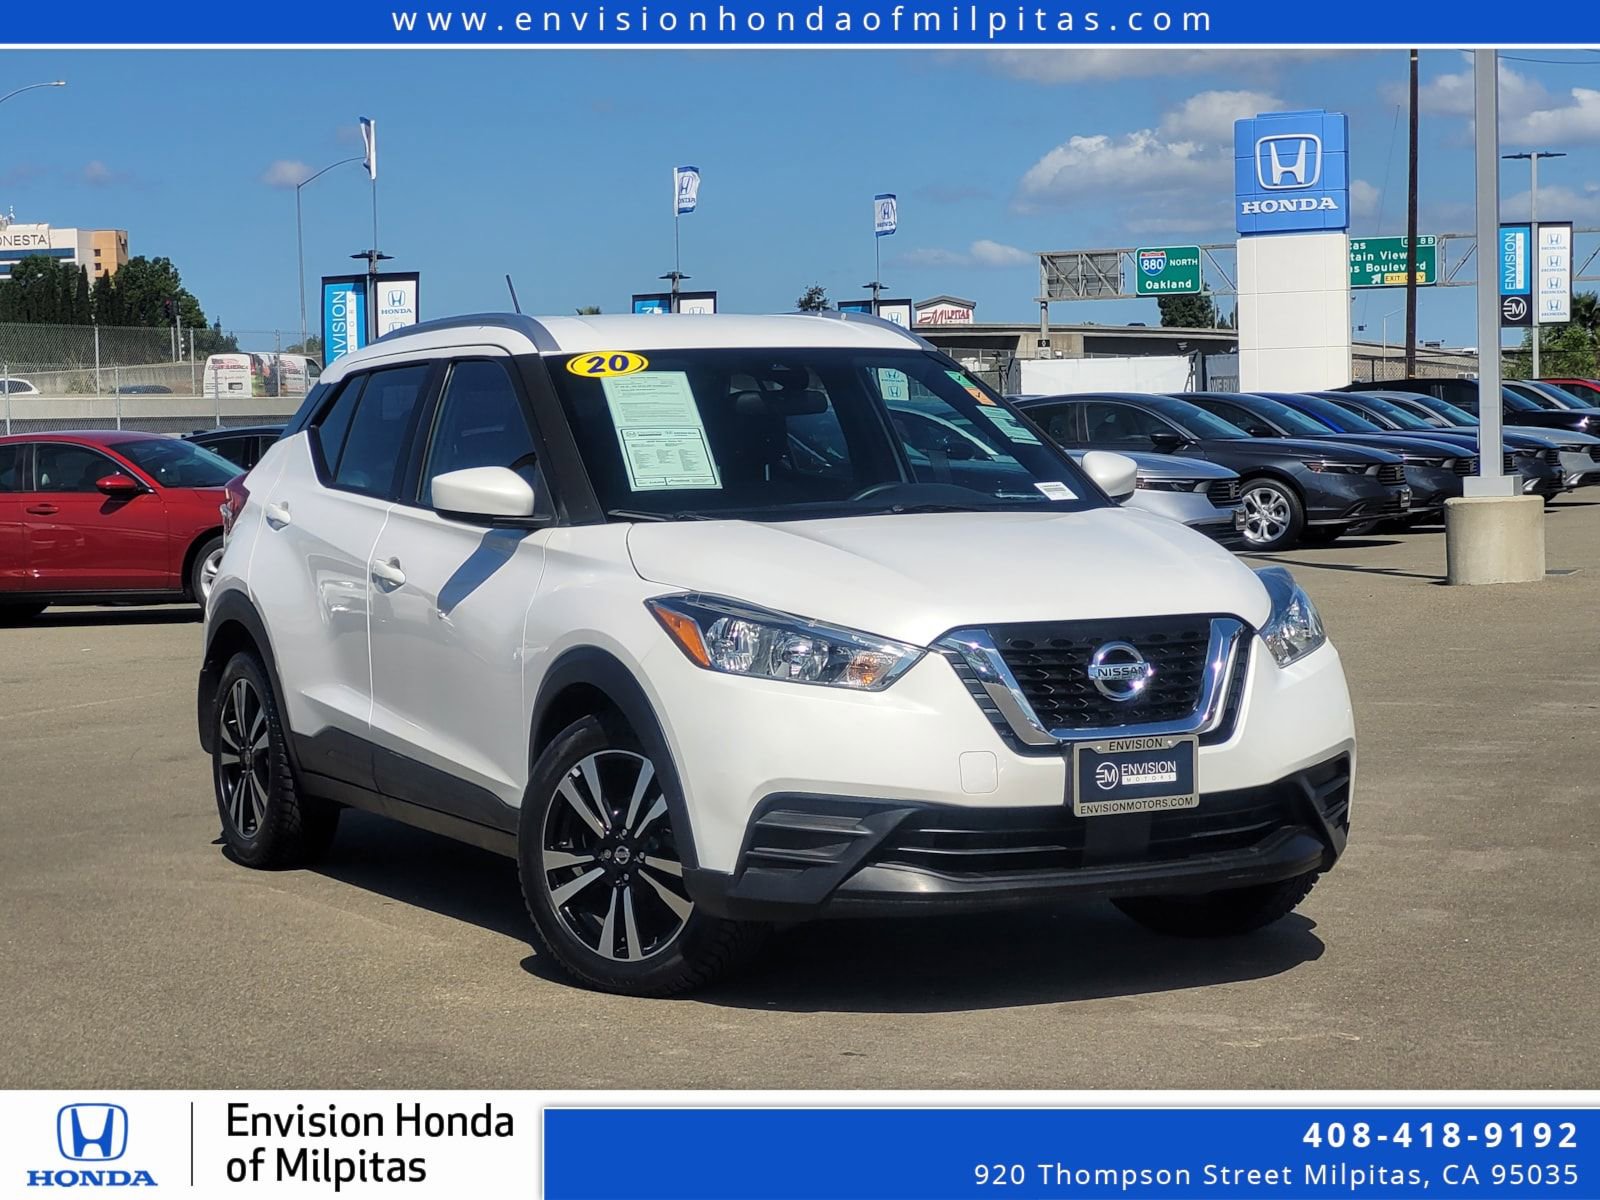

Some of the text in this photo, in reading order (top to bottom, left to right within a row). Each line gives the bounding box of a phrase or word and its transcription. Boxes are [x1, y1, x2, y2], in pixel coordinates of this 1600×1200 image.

[1241, 197, 1339, 214] HONDA
[1380, 250, 1408, 260] View
[1504, 232, 1516, 290] ENVISION
[1143, 258, 1198, 270] 880 NORTH
[1145, 280, 1192, 289] Oakland
[586, 354, 629, 373] 20
[1098, 666, 1145, 677] NISSAN
[1109, 738, 1163, 751] ENVISION
[1121, 760, 1176, 775] ENVISION
[1080, 797, 1193, 814] ENVISIONMOTORS.COM
